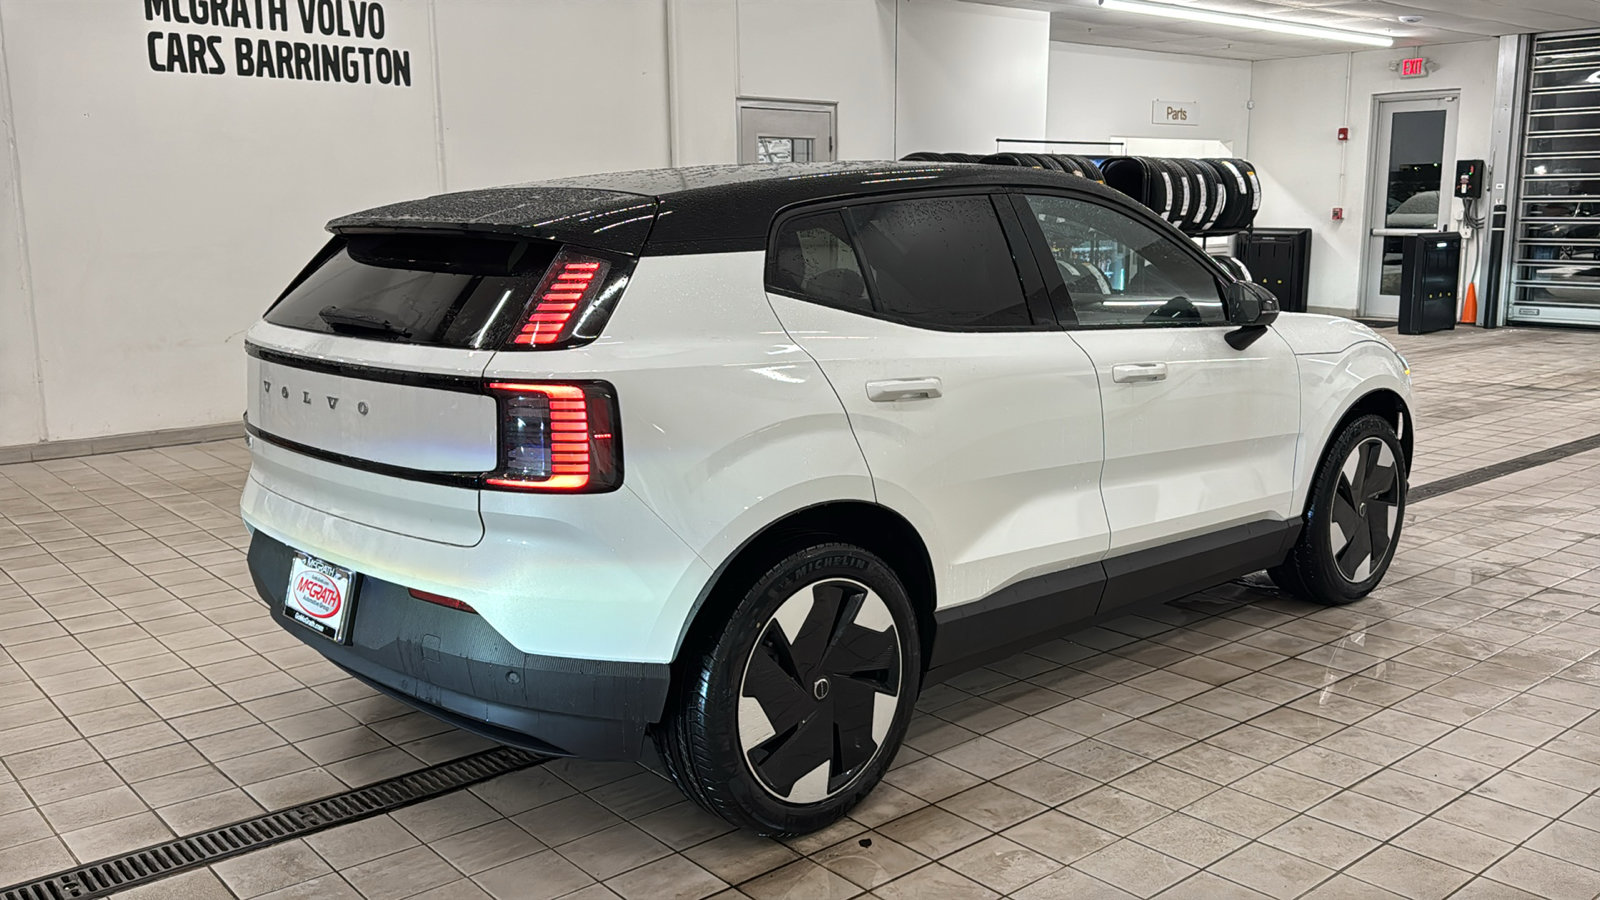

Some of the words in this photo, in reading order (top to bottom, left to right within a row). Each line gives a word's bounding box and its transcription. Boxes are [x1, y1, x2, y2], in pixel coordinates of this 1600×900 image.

[298, 0, 385, 39] VOLVO
[147, 31, 226, 75] CARS
[235, 37, 411, 86] BARRINGTON
[1402, 58, 1424, 76] EXIT
[1166, 106, 1188, 121] Parts
[263, 380, 369, 416] VOLVO
[795, 555, 867, 579] MICHELIN
